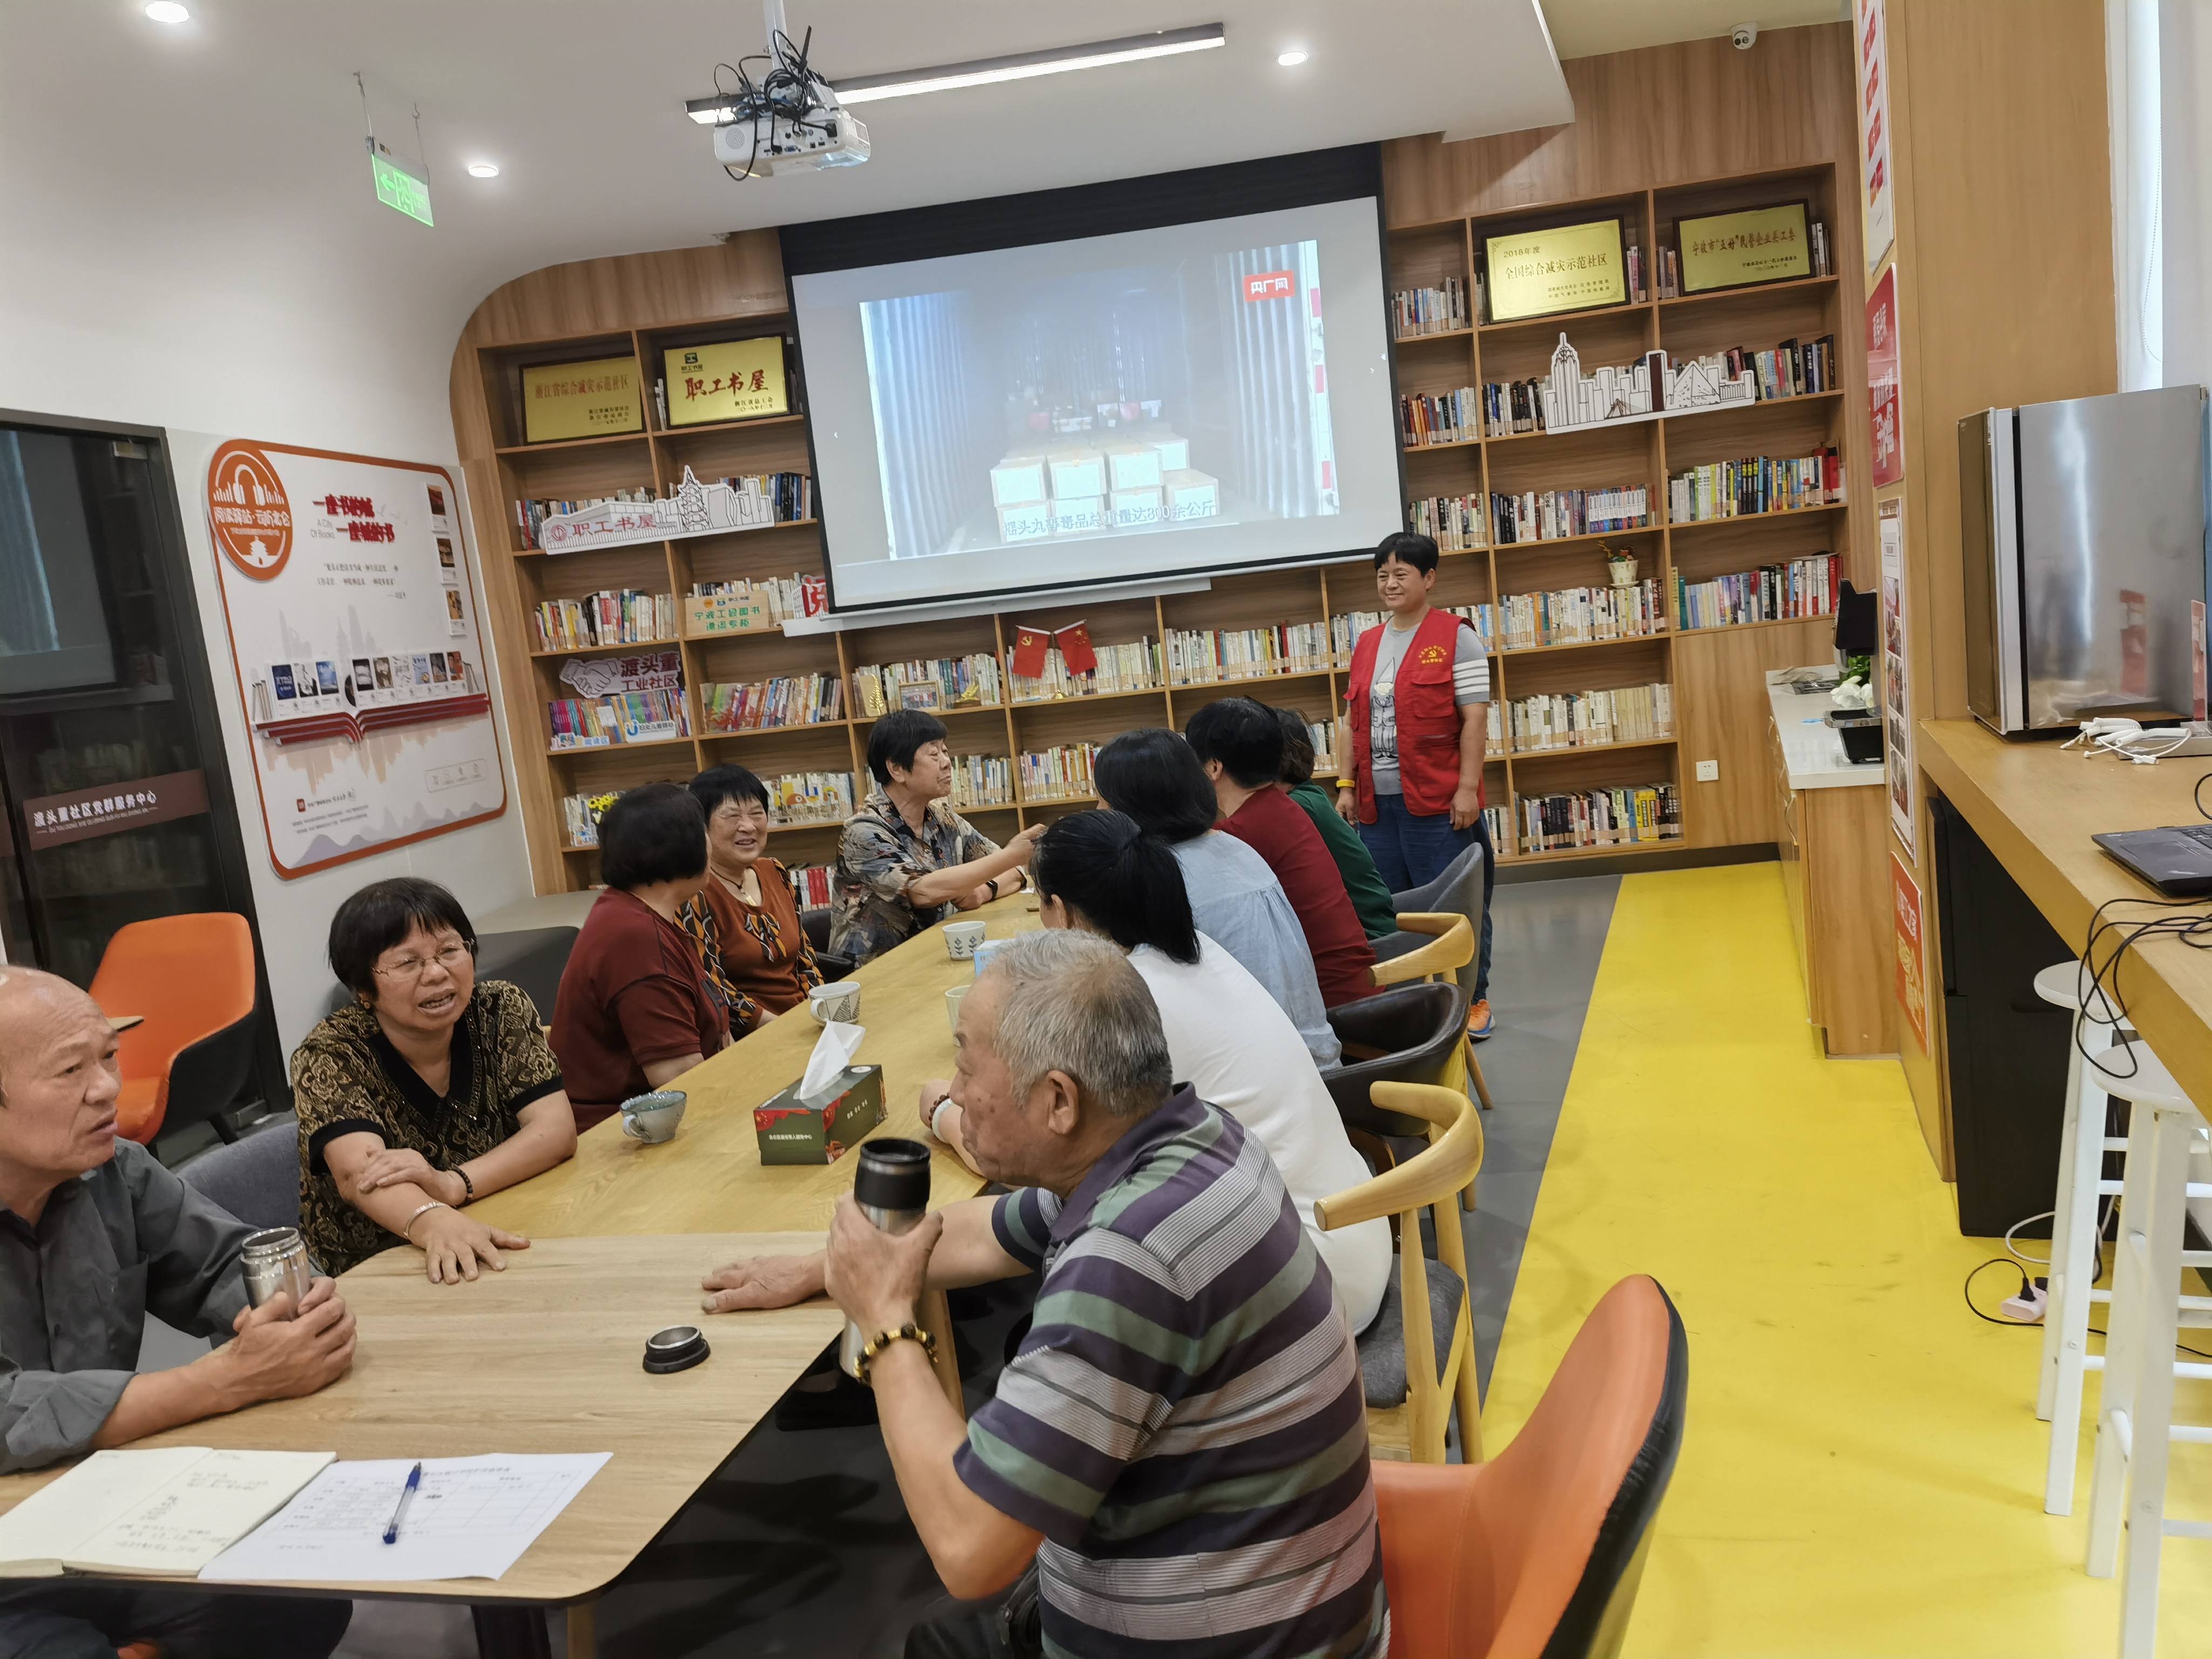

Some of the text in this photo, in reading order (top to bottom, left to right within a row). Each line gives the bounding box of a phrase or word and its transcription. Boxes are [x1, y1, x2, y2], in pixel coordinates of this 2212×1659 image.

[1503, 246, 1540, 258] 2018年度
[1505, 253, 1608, 279] 全国综合减灾示范社区
[1251, 278, 1289, 294] 央广网
[685, 369, 768, 402] 职工书屋
[572, 514, 657, 537] 职工书屋
[1003, 500, 1216, 537] 摇头丸等毒品总重量达800余公斤
[621, 652, 678, 677] 渡头董
[621, 675, 676, 692] 工业社区
